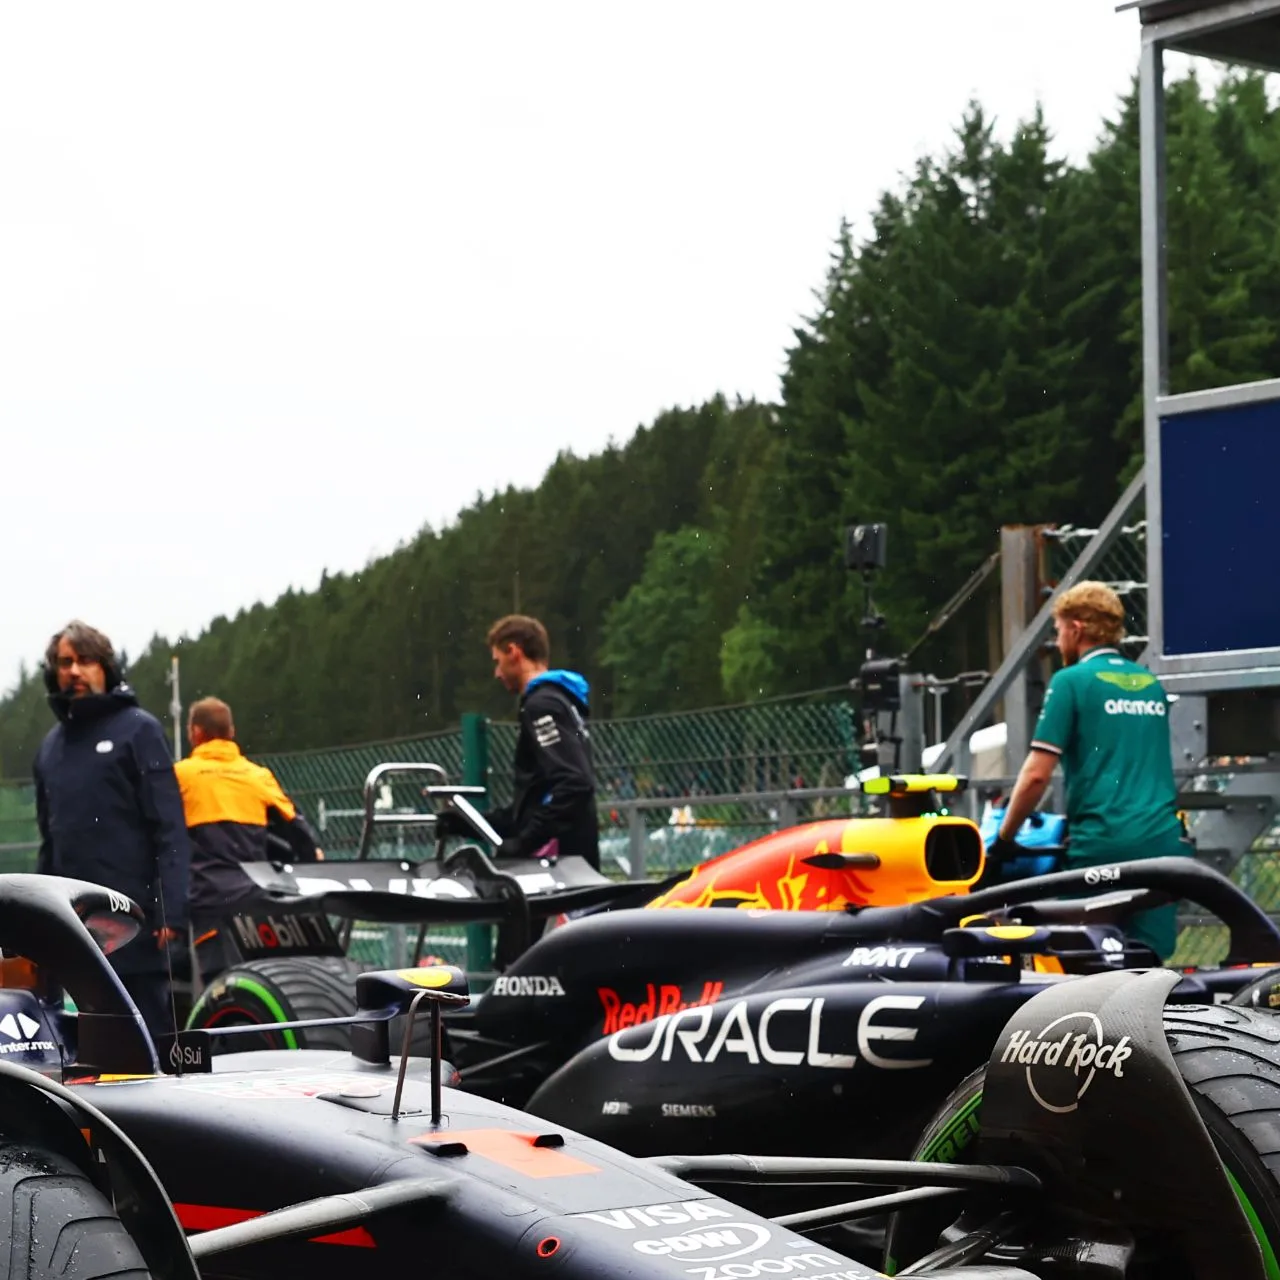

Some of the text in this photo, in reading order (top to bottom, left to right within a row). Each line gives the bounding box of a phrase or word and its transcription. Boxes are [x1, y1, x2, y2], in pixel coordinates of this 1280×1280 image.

[1103, 698, 1167, 717] aramco
[233, 914, 305, 949] Mobil
[492, 976, 566, 997] HONDA
[597, 983, 657, 1035] Red
[607, 995, 935, 1070] ORACLE
[184, 1046, 202, 1066] Sui
[1000, 1029, 1133, 1078] Hard Rock
[661, 1103, 717, 1117] SIEMENS
[567, 1202, 734, 1231] VISA
[632, 1229, 743, 1256] CDW
